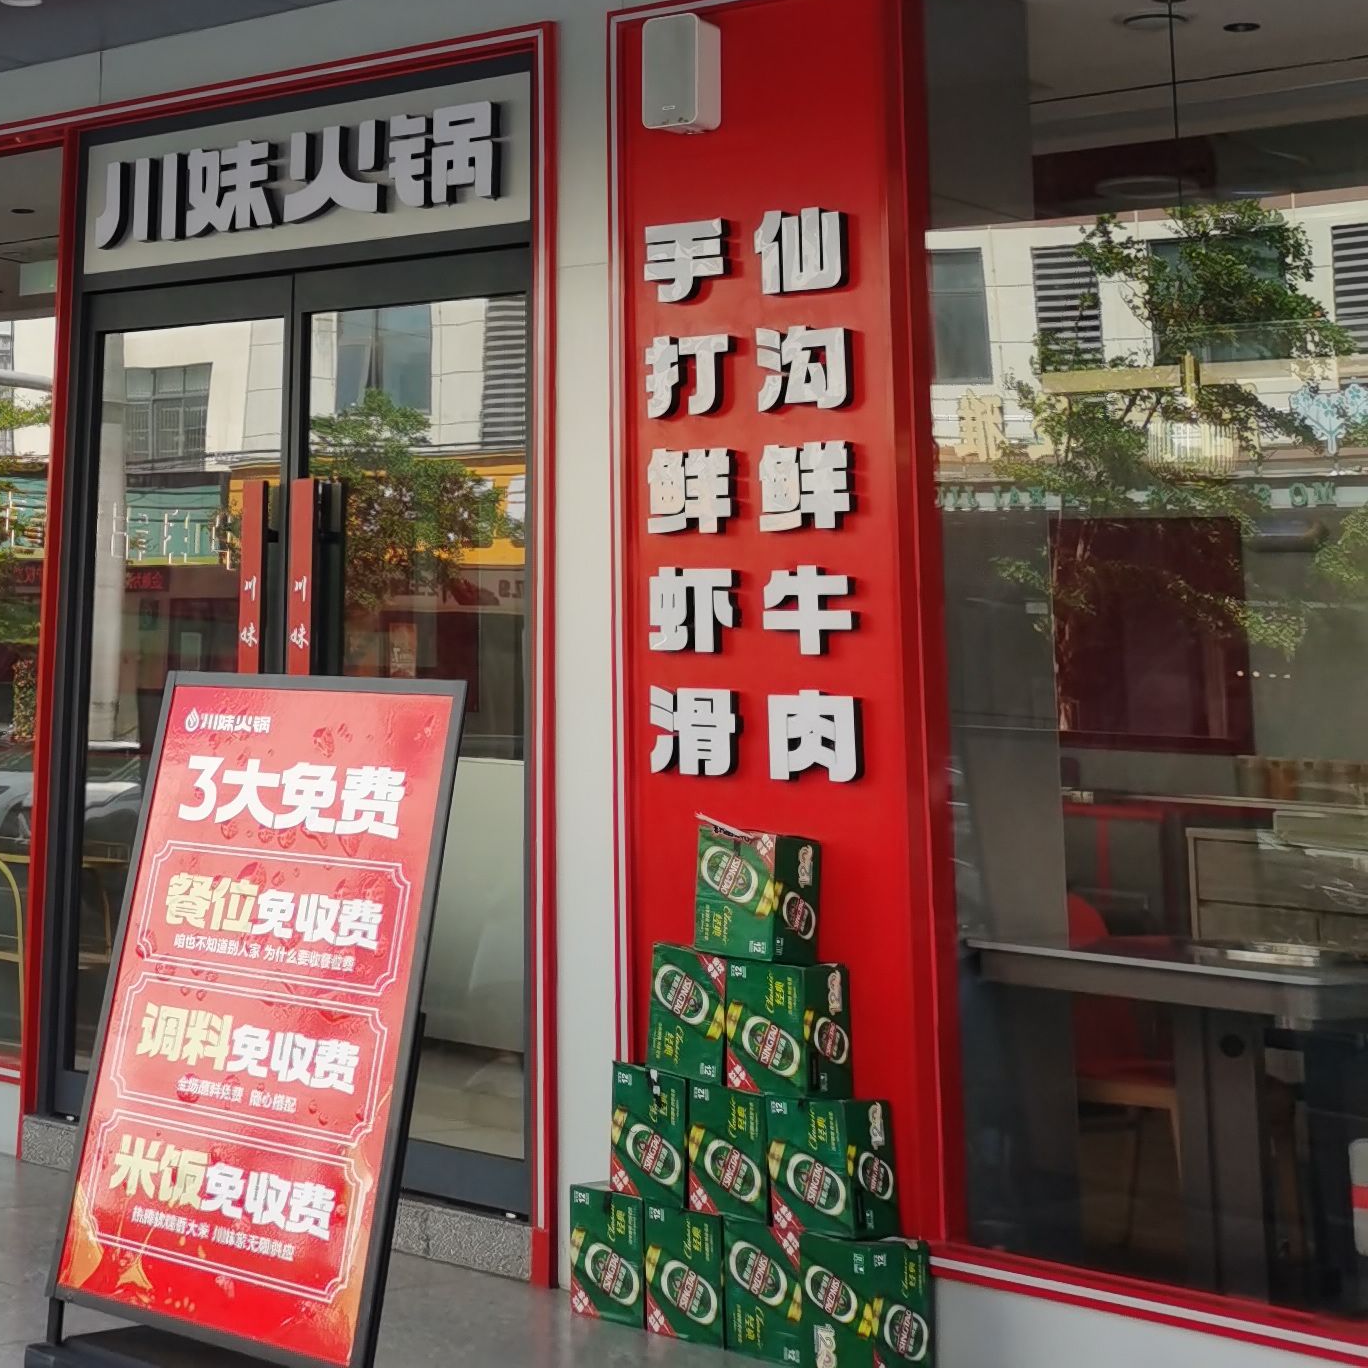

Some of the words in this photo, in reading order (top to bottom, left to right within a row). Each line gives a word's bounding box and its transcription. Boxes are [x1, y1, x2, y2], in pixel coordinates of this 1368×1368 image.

[95, 100, 494, 250] 川妹火锅
[644, 218, 737, 775] 手打鲜虾滑
[754, 207, 857, 782] 仙沟鲜牛肉
[178, 755, 406, 840] 3大免费
[165, 872, 383, 950] 餐位免收费
[136, 1002, 360, 1094] 调料免收费
[109, 1134, 335, 1241] 米饭免收费
